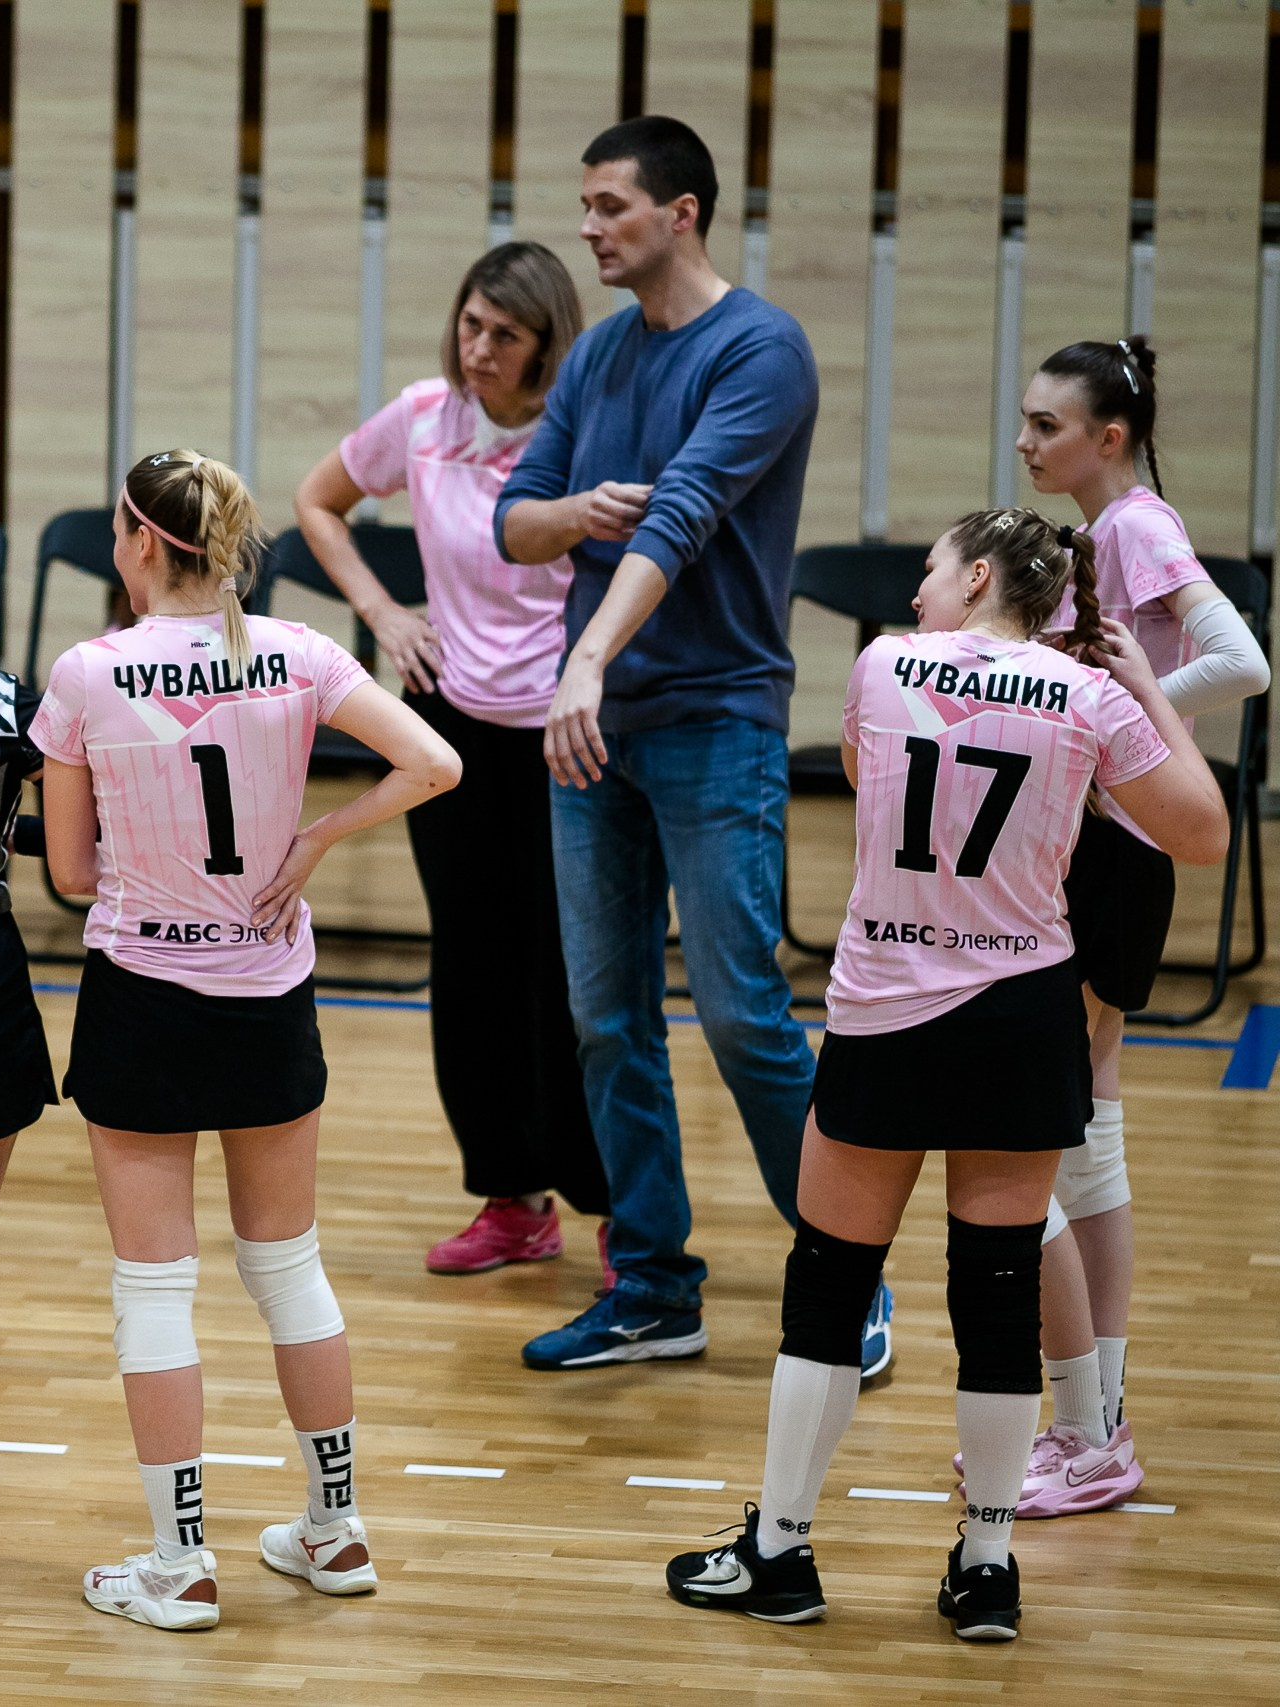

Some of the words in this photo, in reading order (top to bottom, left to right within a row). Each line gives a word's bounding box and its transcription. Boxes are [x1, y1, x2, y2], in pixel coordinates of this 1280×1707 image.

[113, 653, 288, 699] ЧУВАШИЯ
[894, 656, 1069, 714] ЧУВАШИЯ
[190, 743, 245, 876] 1
[895, 735, 1033, 879] 17
[165, 923, 221, 943] АБС
[880, 922, 936, 946] АБС
[943, 927, 1039, 956] Электро
[312, 1431, 352, 1509] ELITE
[980, 1504, 1018, 1525] erre
